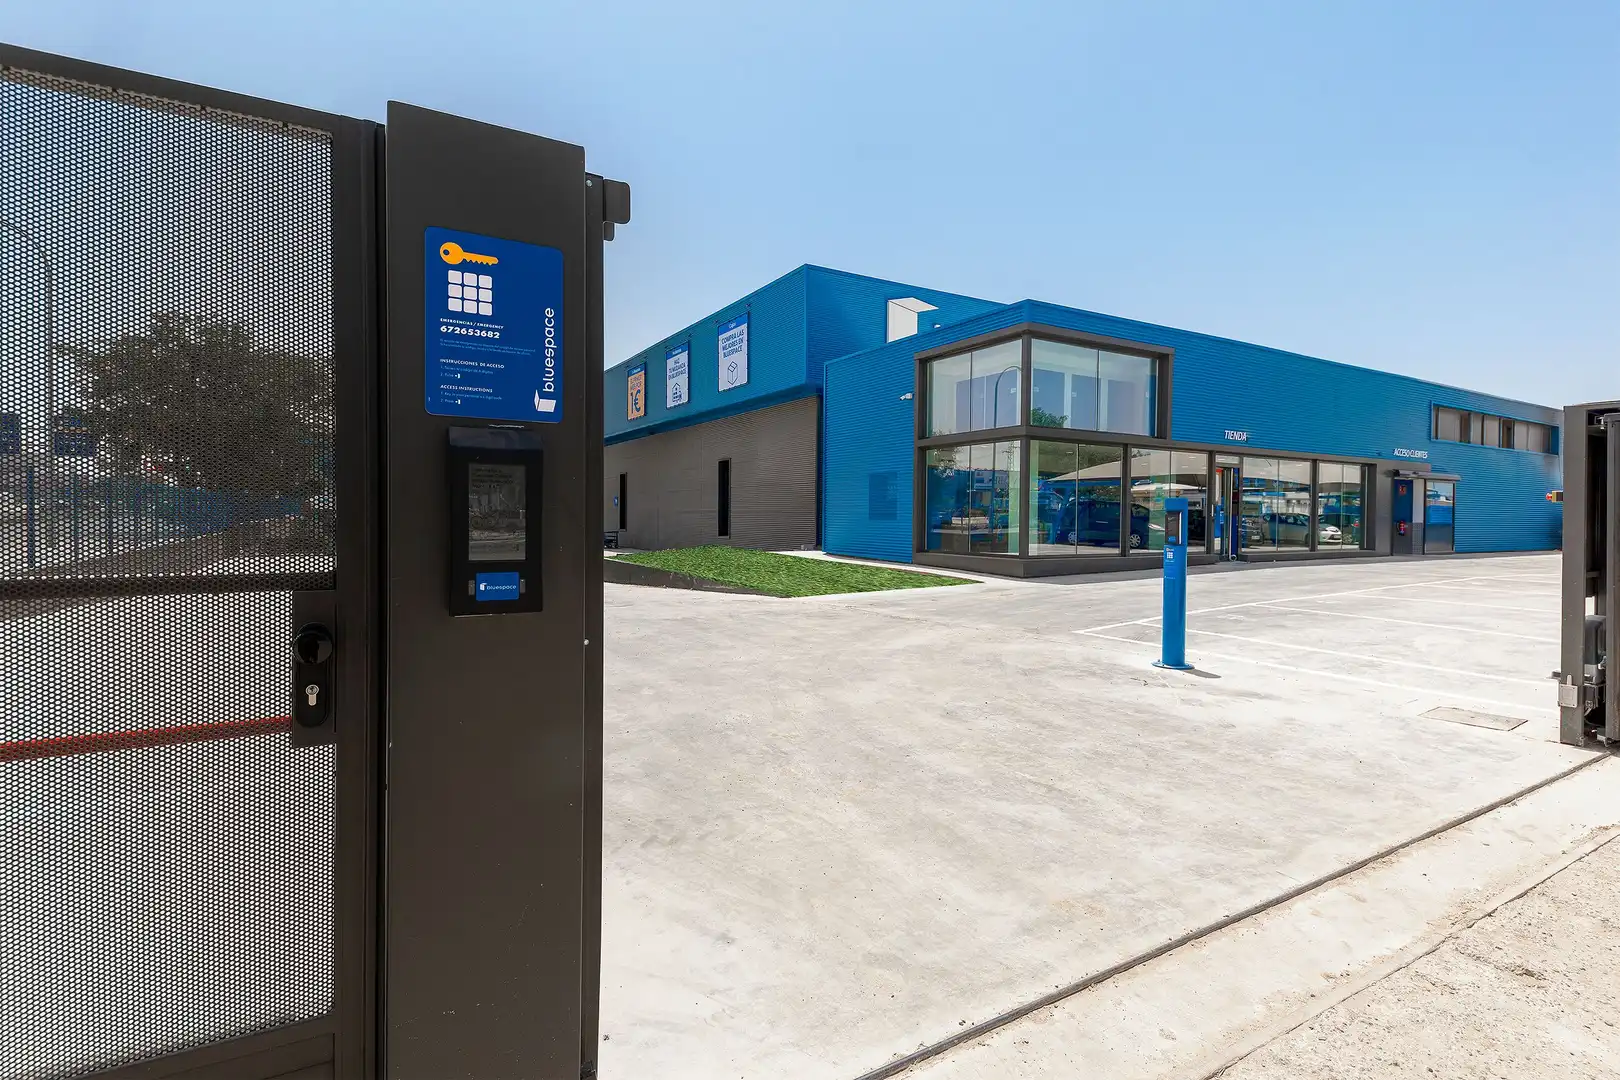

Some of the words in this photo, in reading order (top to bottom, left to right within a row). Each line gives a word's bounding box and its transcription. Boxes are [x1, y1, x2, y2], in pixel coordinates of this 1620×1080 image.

[440, 318, 473, 326] EMERGENCIAS
[440, 325, 500, 339] 672653682
[721, 333, 737, 345] COMPRA
[736, 329, 745, 337] LAS
[542, 308, 557, 392] bluespace
[722, 340, 739, 351] MEJORES
[723, 345, 743, 358] BLUESPACE
[440, 358, 478, 366] INSTRUCCIONES
[1224, 429, 1247, 441] TIENDA
[1393, 448, 1410, 458] ACCESO
[1410, 449, 1428, 459] CLIENTES
